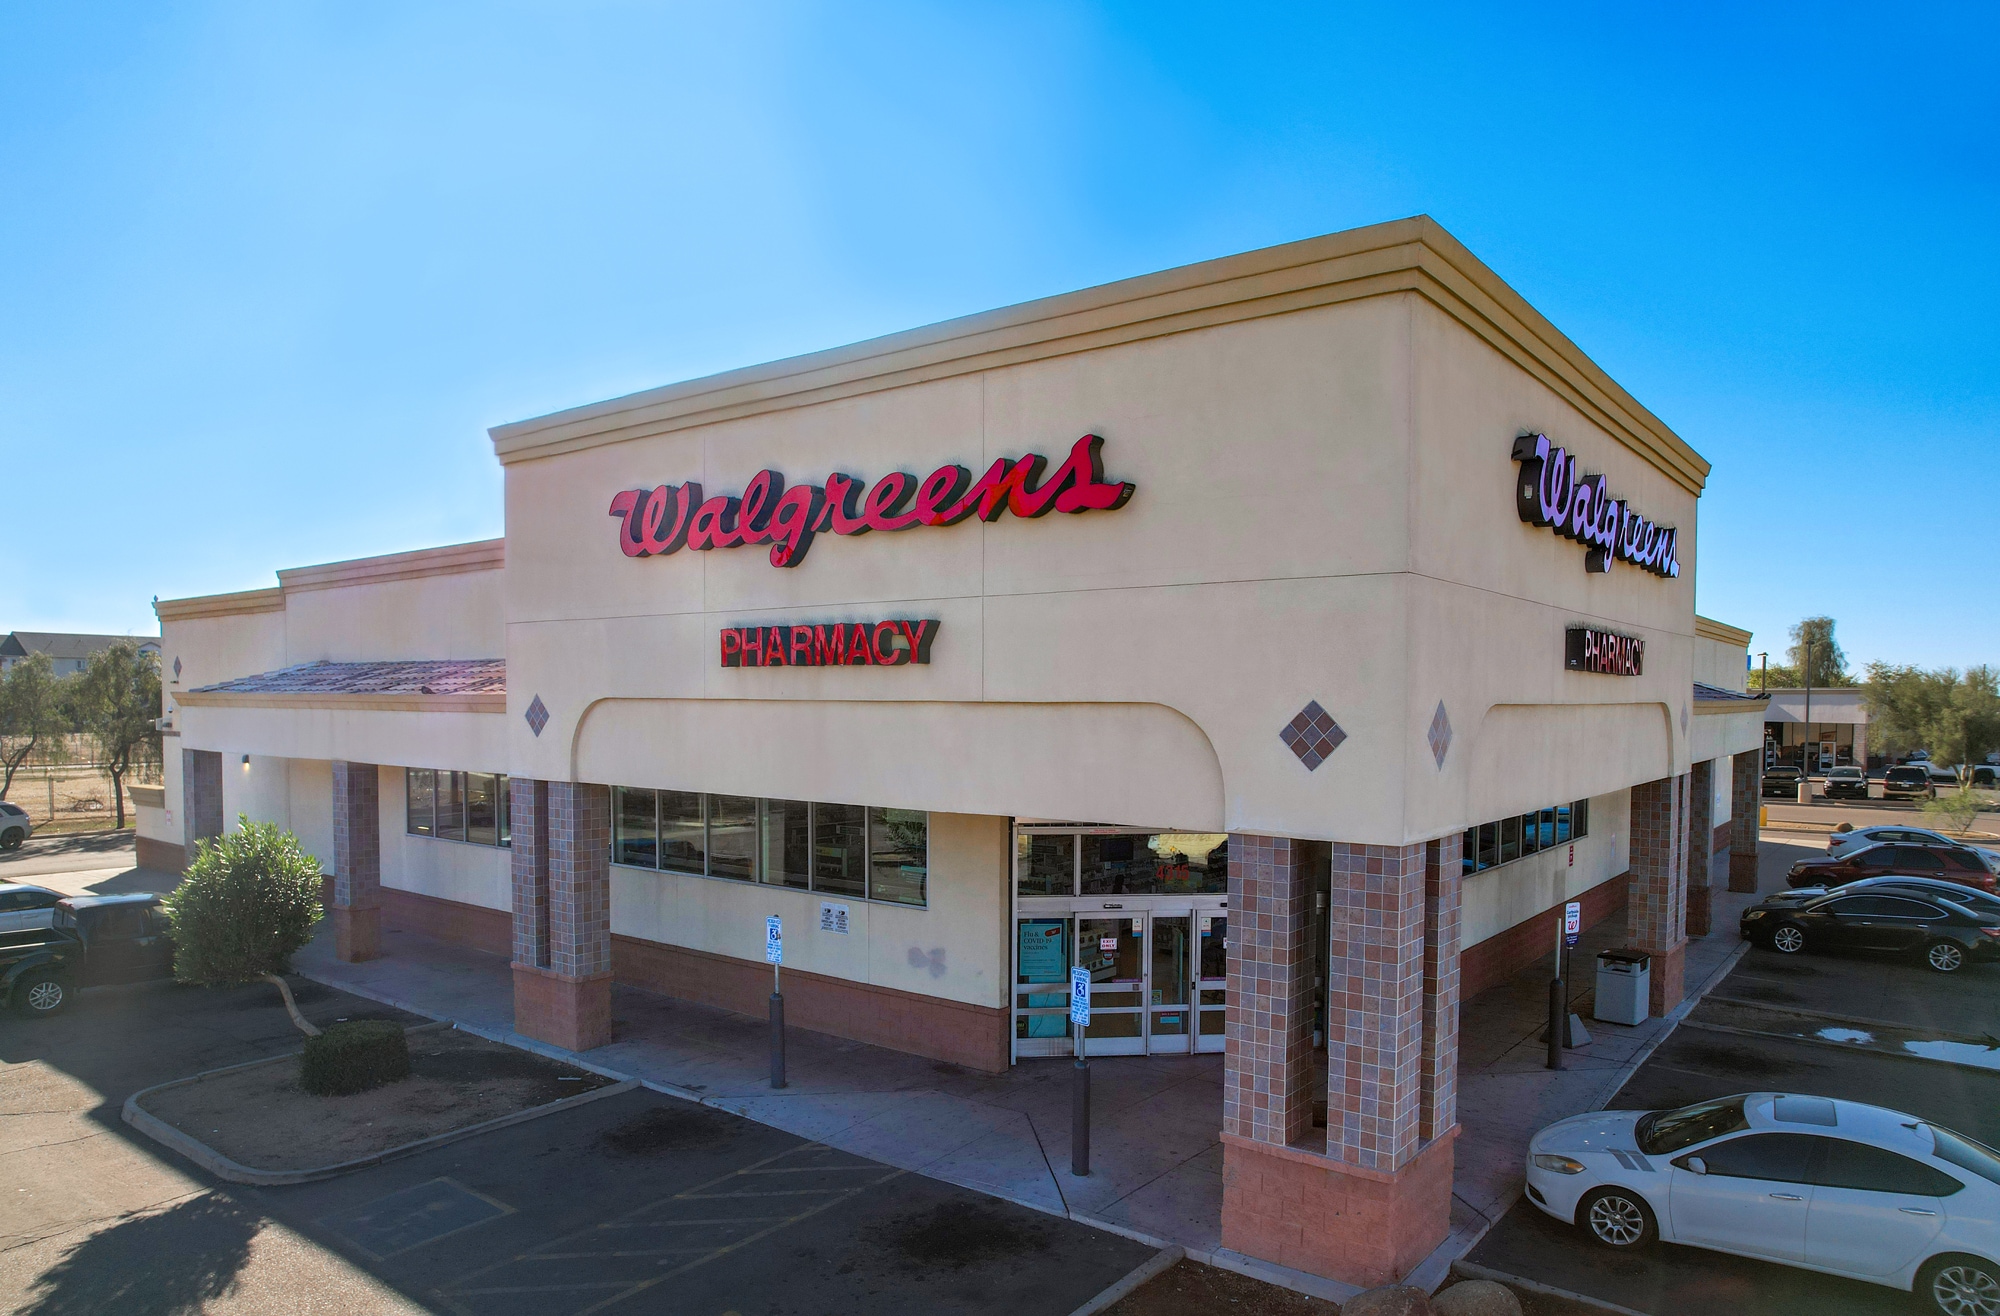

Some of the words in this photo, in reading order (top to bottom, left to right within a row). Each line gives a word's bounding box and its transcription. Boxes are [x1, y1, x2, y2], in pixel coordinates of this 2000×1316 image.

[608, 433, 1135, 568] Walgreens
[1535, 433, 1680, 579] Walgreens
[720, 619, 938, 668] PHARMACY
[1585, 629, 1646, 676] PHARMACY
[1156, 864, 1190, 881] 4315
